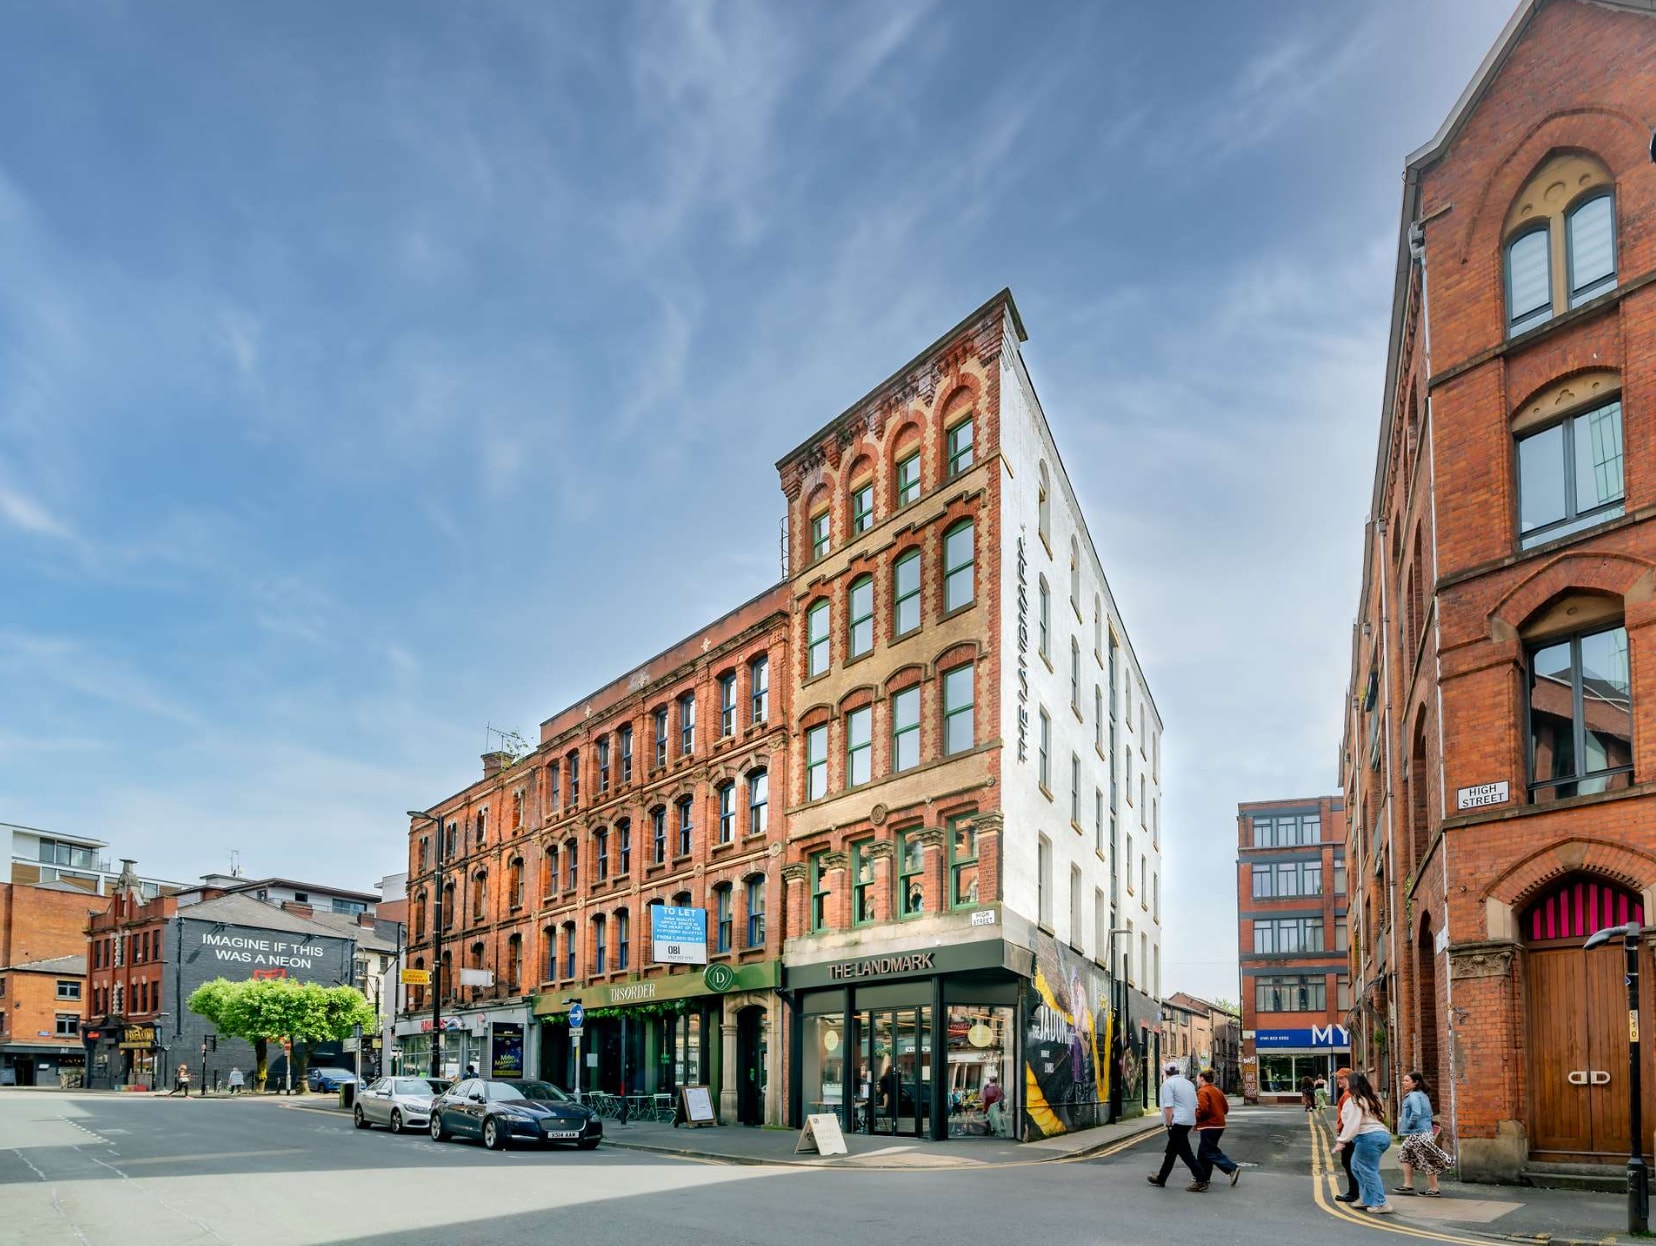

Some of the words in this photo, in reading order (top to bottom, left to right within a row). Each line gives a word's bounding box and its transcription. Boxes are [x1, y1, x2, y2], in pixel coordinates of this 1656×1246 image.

[1462, 792, 1504, 807] STREET
[1469, 784, 1497, 796] HIGH
[662, 907, 675, 915] TO
[678, 909, 697, 917] LET
[202, 933, 270, 951] IMAGINE
[273, 942, 288, 953] IF
[291, 944, 324, 957] THIS
[215, 949, 252, 963] WAS
[254, 954, 266, 965] A
[269, 955, 311, 969] NEON
[827, 963, 853, 979] THE
[855, 952, 934, 977] LANDMARK
[716, 972, 725, 983] D
[611, 983, 655, 1002] DISORDER
[1040, 1005, 1067, 1045] JADON
